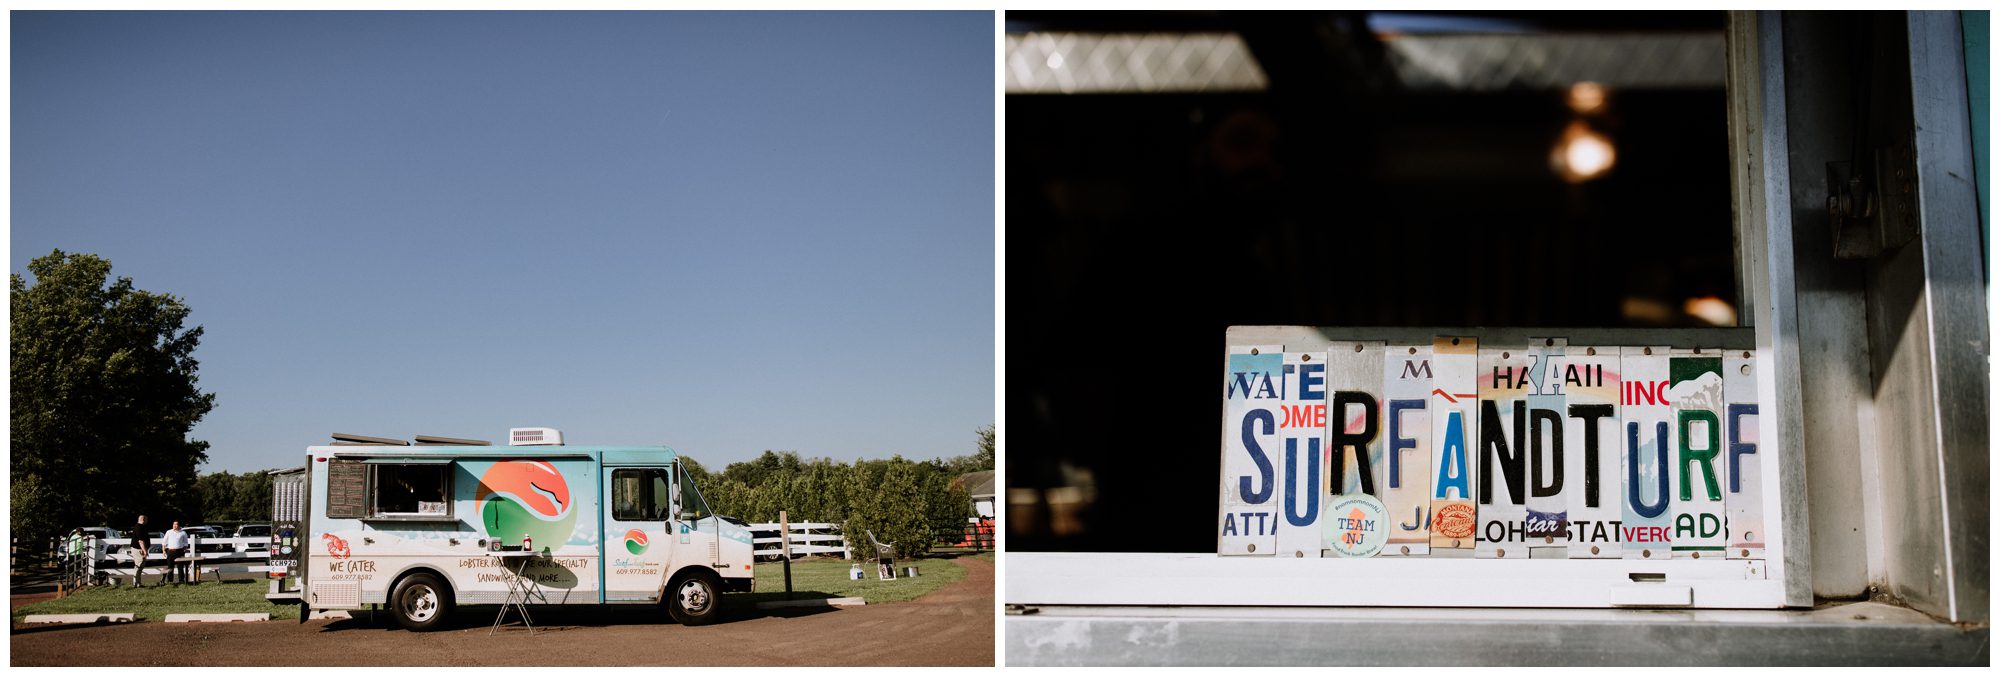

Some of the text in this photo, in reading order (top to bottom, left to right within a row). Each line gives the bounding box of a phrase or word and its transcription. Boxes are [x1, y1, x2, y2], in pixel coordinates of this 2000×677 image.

[1400, 359, 1433, 379] M
[1228, 371, 1279, 400] WA
[1440, 504, 1474, 516] MONTANA
[1337, 517, 1376, 532] TEAM
[1526, 511, 1558, 533] tar
[1676, 513, 1720, 539] AD
[1346, 532, 1365, 545] NJ
[329, 560, 377, 573] WE CATER
[459, 559, 488, 569] LOBSTER
[537, 559, 550, 568] OUR
[554, 558, 588, 569] SPECIALTY
[477, 573, 516, 583] SANDWIHE
